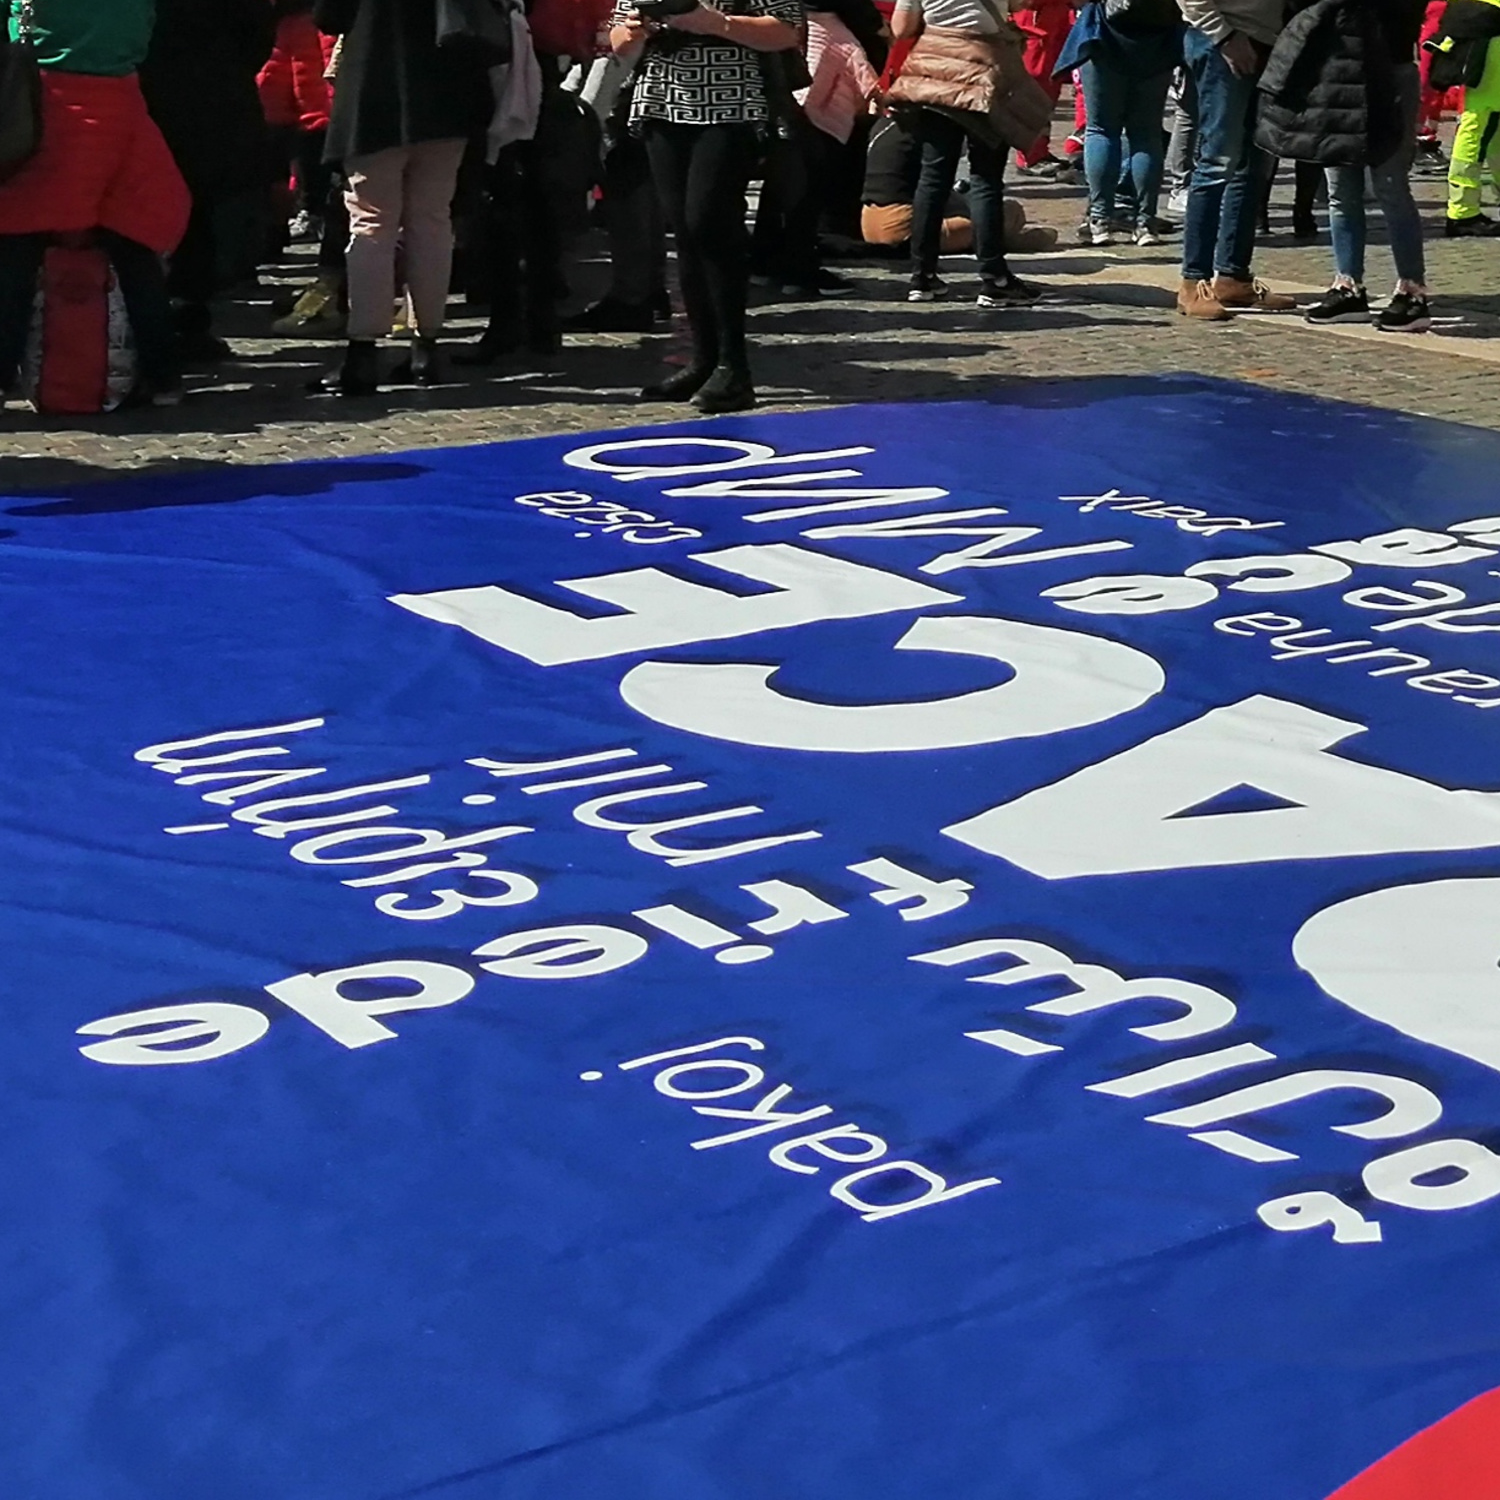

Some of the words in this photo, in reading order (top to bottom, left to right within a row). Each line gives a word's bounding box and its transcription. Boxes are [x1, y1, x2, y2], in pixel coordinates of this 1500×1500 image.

[515, 491, 702, 543] cisza
[1059, 489, 1285, 540] paix
[463, 748, 823, 867] mir
[76, 857, 974, 1065] friede
[580, 1037, 1001, 1222] pakoj
